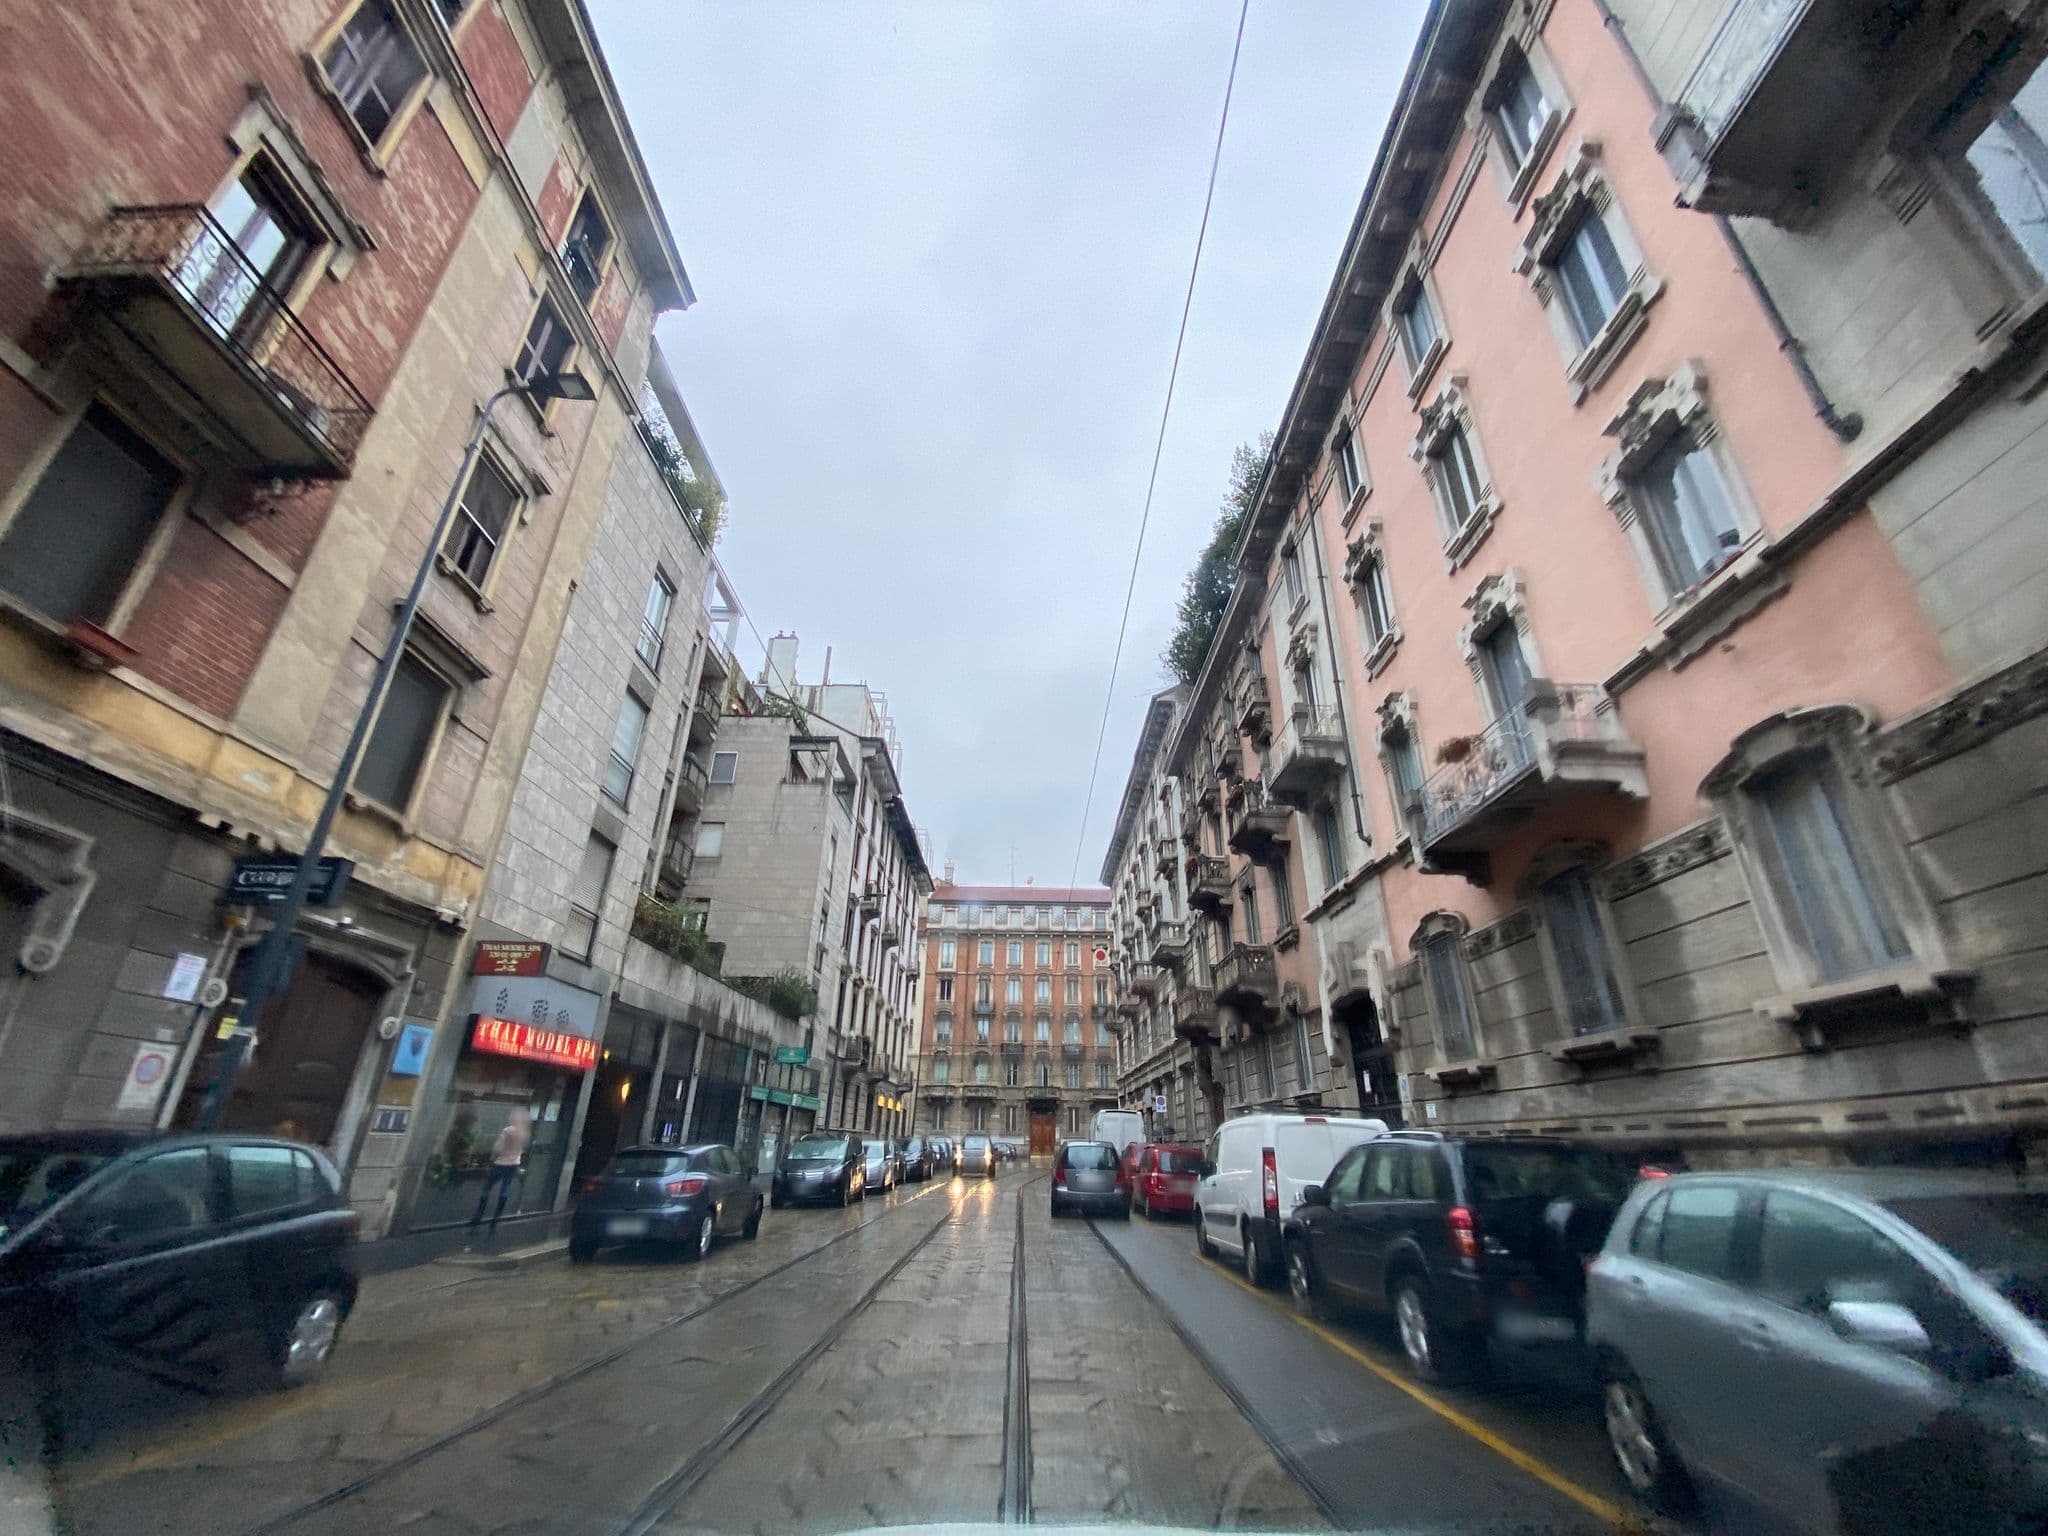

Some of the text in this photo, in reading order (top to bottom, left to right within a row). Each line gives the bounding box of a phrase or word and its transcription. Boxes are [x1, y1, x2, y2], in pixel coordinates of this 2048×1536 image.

[480, 1021, 520, 1043] THAI
[526, 1026, 570, 1055] MODEL
[575, 1038, 596, 1060] SPA
